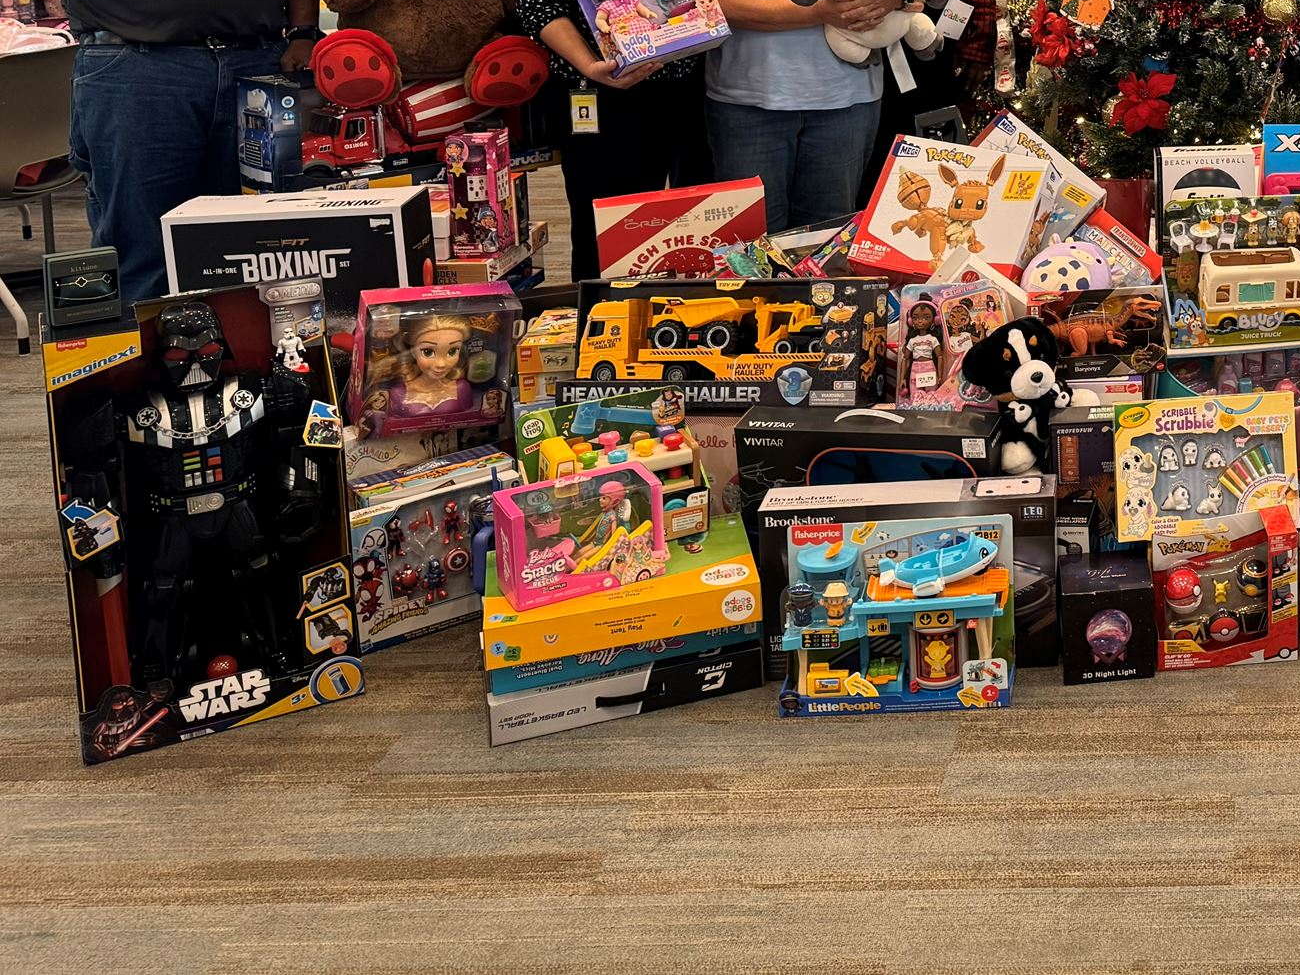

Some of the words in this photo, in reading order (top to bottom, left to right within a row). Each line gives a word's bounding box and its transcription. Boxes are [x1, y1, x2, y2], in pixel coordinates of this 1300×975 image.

[621, 33, 650, 52] baby
[627, 44, 656, 62] alive
[1000, 119, 1017, 135] MEGA
[900, 146, 919, 156] MEGA
[320, 199, 383, 208] BOXING
[704, 206, 734, 216] HELLO
[704, 212, 736, 222] KITTY
[663, 235, 694, 250] THE
[1112, 225, 1147, 256] TRANSFORMERS
[70, 263, 98, 273] kitsune
[223, 248, 351, 283] BOXING
[339, 260, 351, 268] SET
[203, 267, 237, 275] ALL-IN-ONE
[845, 287, 857, 295] 3+
[1239, 312, 1285, 331] BLUEY
[1240, 332, 1259, 340] JUICE
[1260, 331, 1282, 339] TRUCK
[588, 339, 606, 347] HEAVY
[607, 337, 622, 345] DUTY
[594, 343, 617, 351] HAULER
[51, 344, 137, 387] imaginext
[753, 362, 774, 370] DUTY
[1075, 365, 1101, 373] Baryonyx
[735, 368, 765, 376] HAULER
[562, 387, 624, 402] HEAVY
[686, 387, 761, 403] HAULER
[1161, 407, 1197, 418] SCRIBBLE
[748, 420, 795, 429] VIVITAR
[1155, 416, 1214, 433] Scrubbie
[1269, 415, 1289, 425] PETS
[524, 421, 540, 431] Leap
[1250, 424, 1286, 434] NURSERY
[526, 427, 541, 438] Frog
[743, 437, 784, 447] VIVITAR
[554, 475, 593, 488] Barbie
[1023, 506, 1044, 516] LED
[764, 515, 834, 528] Brookstone
[794, 530, 841, 539] fisher-price
[983, 530, 999, 539] B12
[528, 549, 556, 564] Barbie
[374, 599, 426, 622] SPIDEY
[610, 627, 626, 635] Tent
[627, 625, 643, 633] Play
[577, 646, 624, 666] Along
[697, 661, 733, 675] CIPTON
[1082, 671, 1093, 679] 3D
[1095, 670, 1116, 679] Night
[1117, 667, 1137, 677] Light
[517, 668, 548, 680] Bluetooth
[179, 670, 270, 707] STAR
[179, 685, 271, 723] WARS
[291, 692, 307, 707] 3+
[515, 711, 535, 720] HOOP
[567, 706, 587, 716] LED
[498, 716, 515, 725] SET
[498, 711, 566, 731] BASKETBALL
